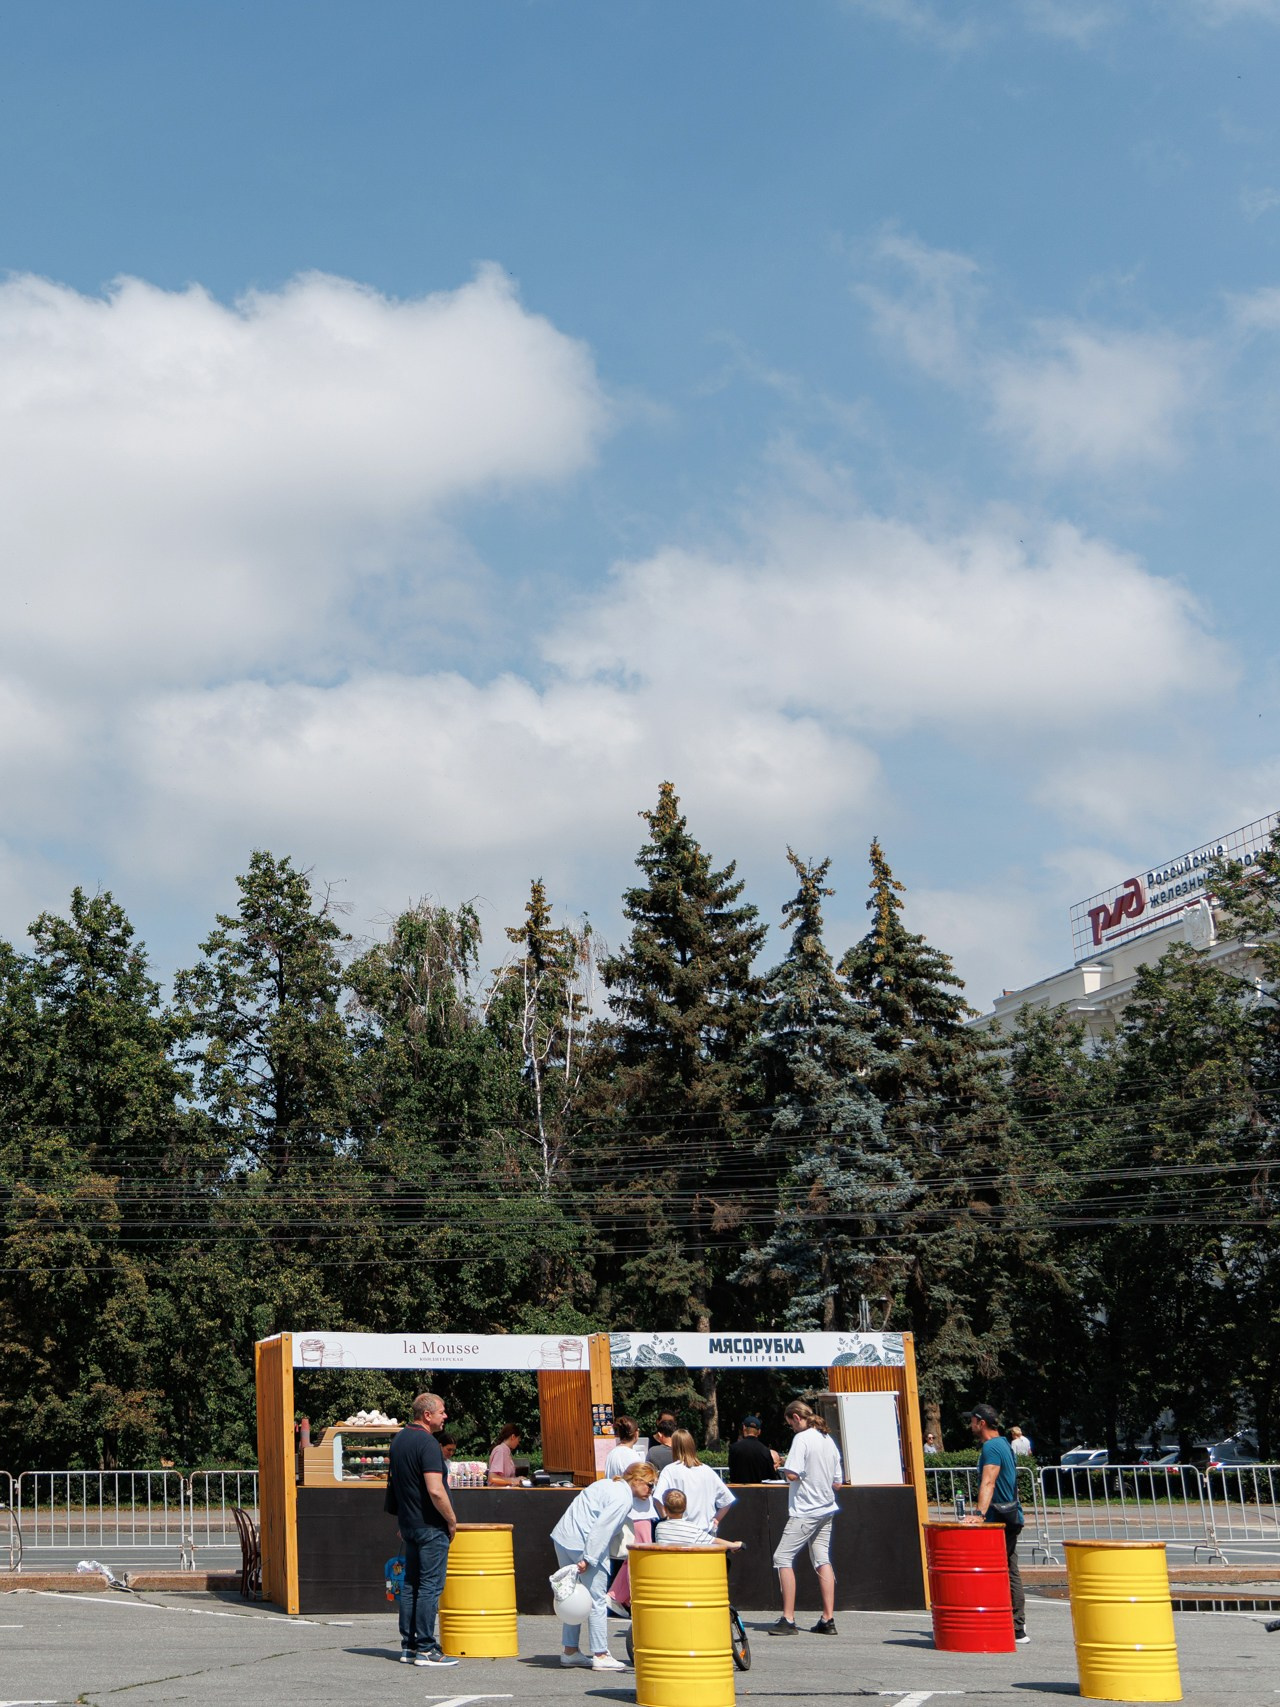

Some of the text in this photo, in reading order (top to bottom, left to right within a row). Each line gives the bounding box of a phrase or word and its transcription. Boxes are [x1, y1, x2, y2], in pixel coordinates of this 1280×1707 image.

[1146, 845, 1224, 888] Российские
[403, 1340, 480, 1354] la Mousse
[709, 1338, 805, 1354] МЯСОРУБКА
